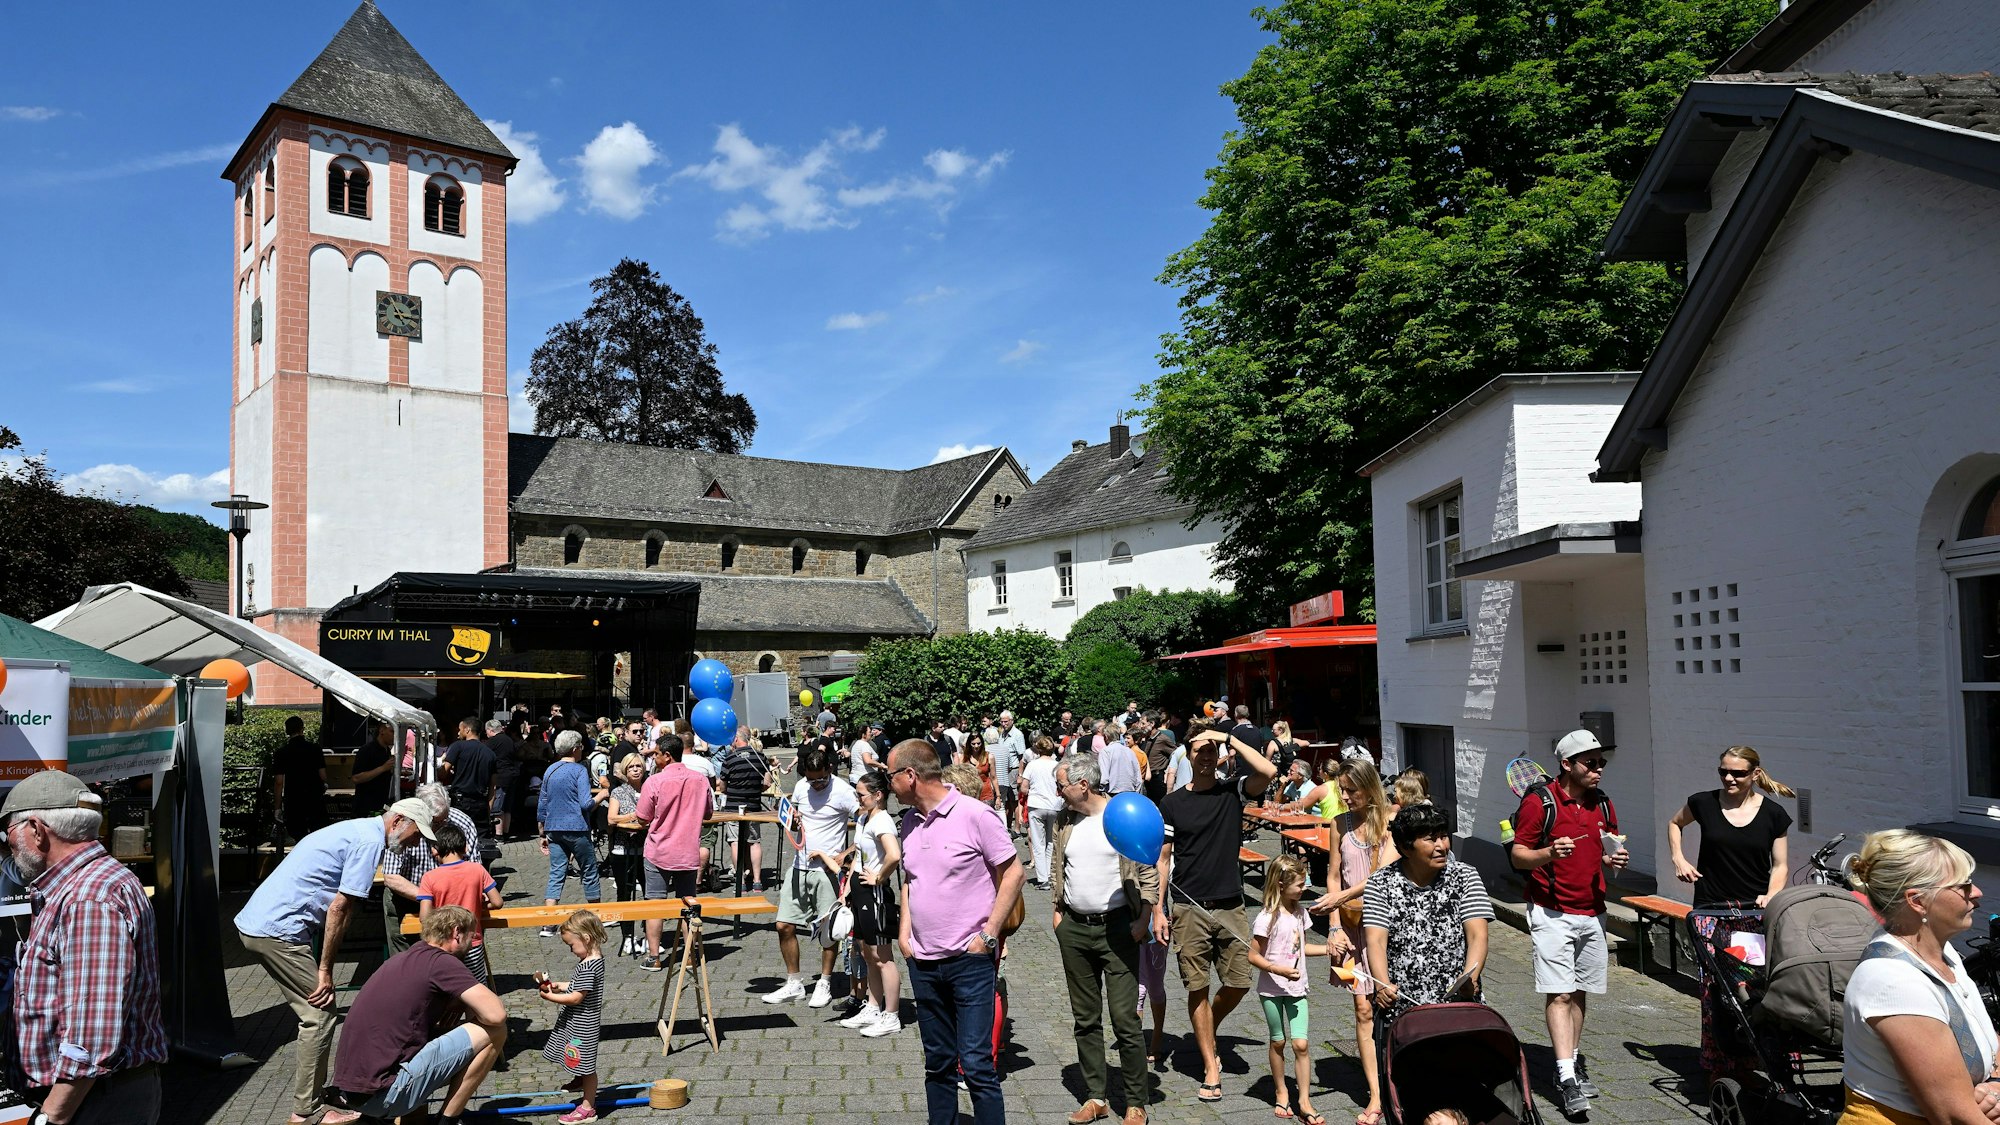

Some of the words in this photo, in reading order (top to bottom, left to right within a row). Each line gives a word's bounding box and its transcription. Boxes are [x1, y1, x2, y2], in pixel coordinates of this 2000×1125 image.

[327, 628, 373, 641] CURRY
[377, 629, 394, 641] IM
[399, 629, 431, 642] THAL
